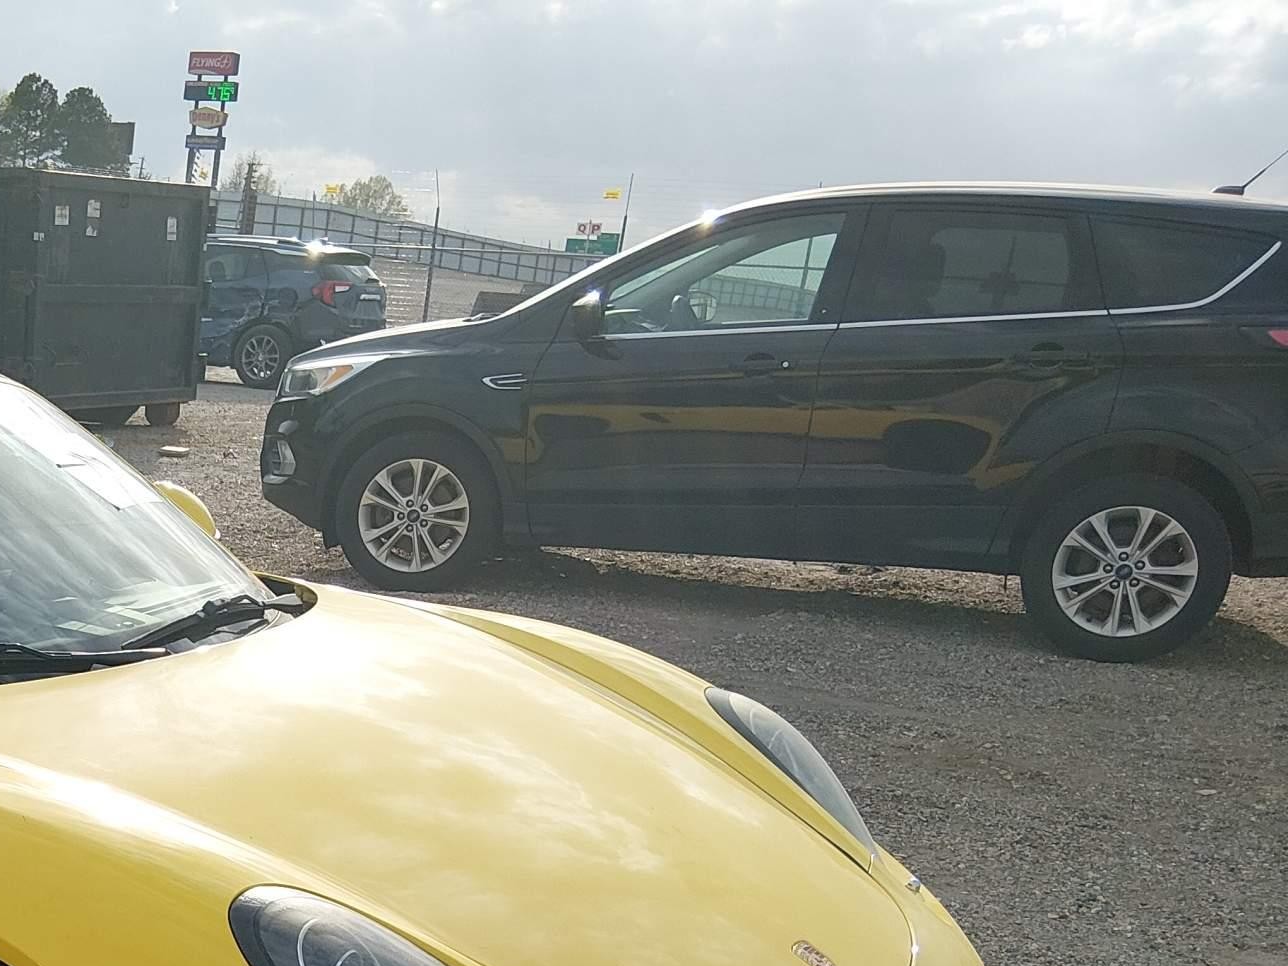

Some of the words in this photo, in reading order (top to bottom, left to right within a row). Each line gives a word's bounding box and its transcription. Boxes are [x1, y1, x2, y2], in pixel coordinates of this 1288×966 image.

[191, 57, 221, 67] FLYING
[577, 224, 587, 234] Q
[591, 224, 601, 234] P
